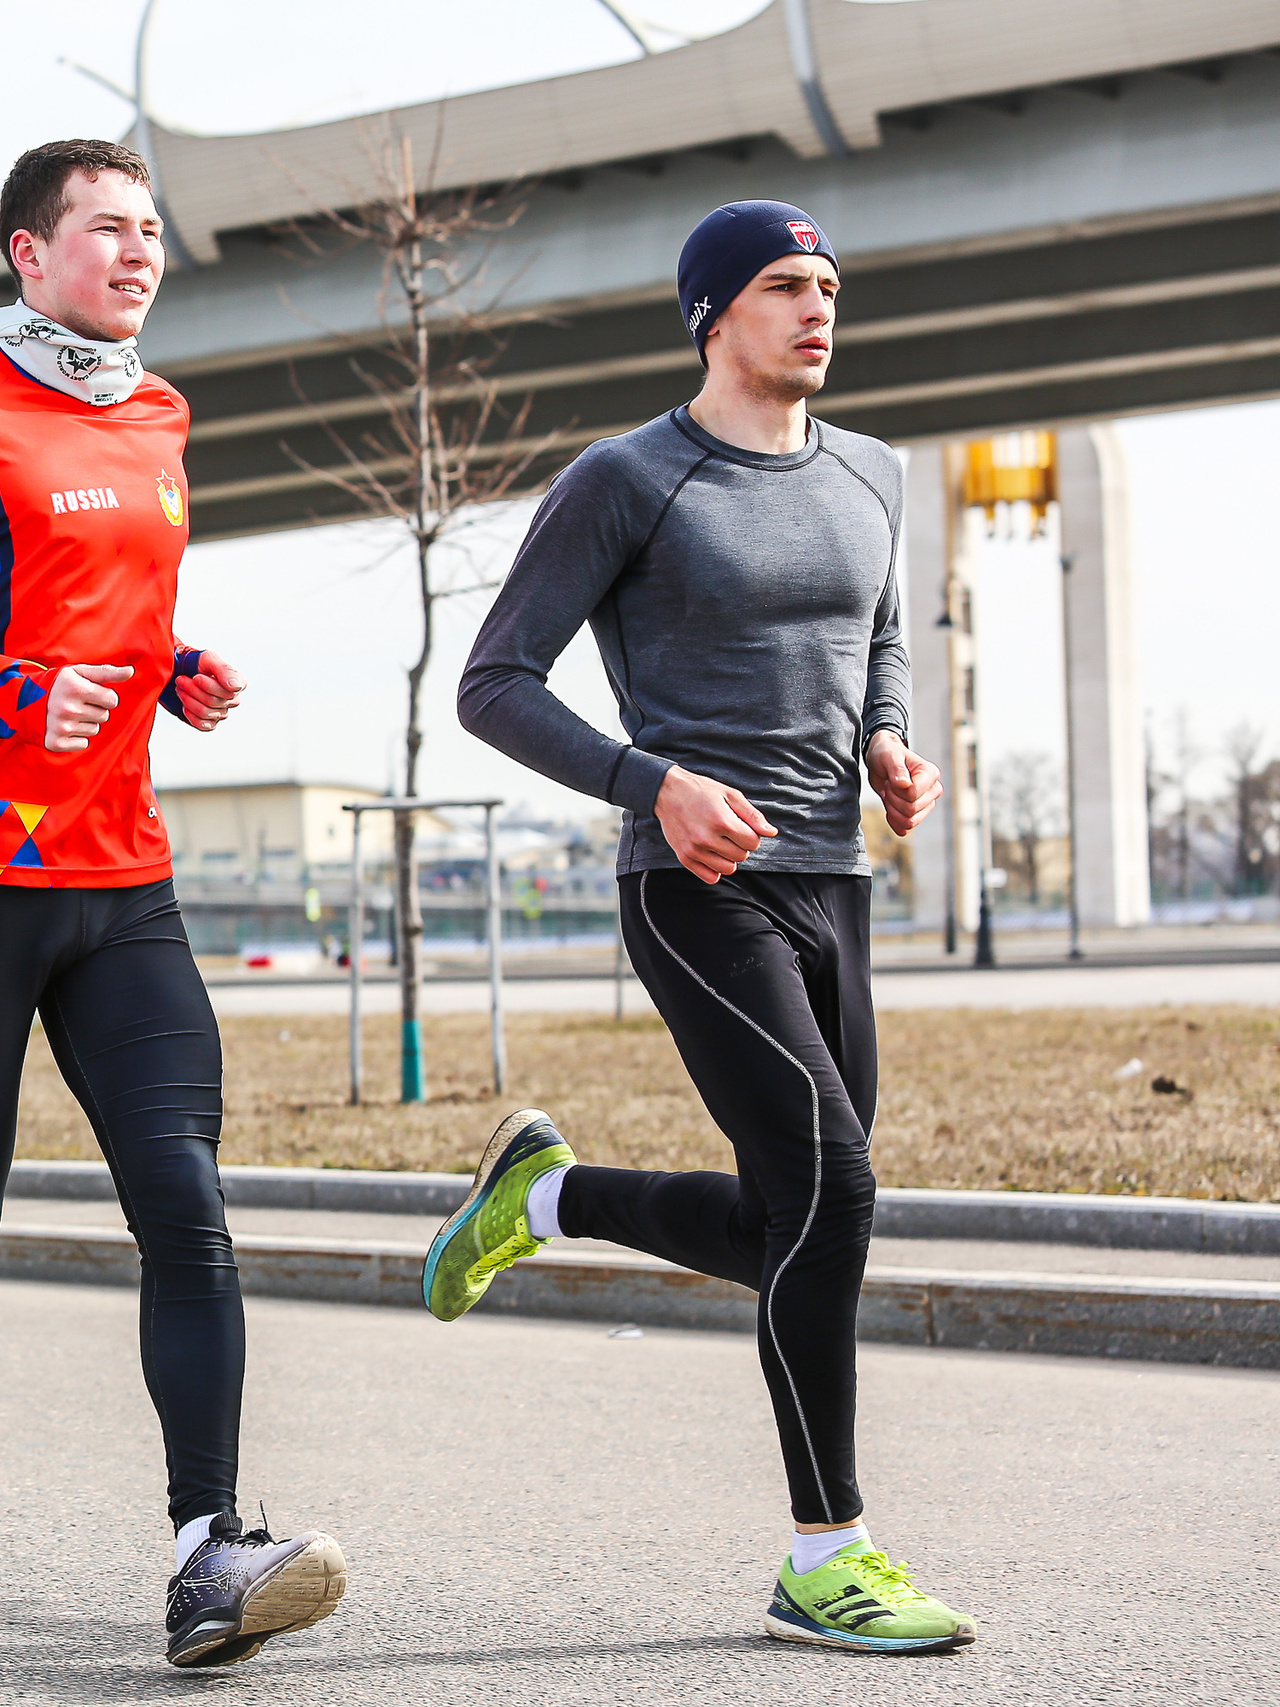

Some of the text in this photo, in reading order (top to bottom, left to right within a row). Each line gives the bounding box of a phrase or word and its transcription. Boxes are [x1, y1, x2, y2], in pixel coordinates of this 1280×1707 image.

[689, 296, 712, 338] swix
[57, 360, 71, 378] WORLD
[50, 486, 120, 515] RUSSIA
